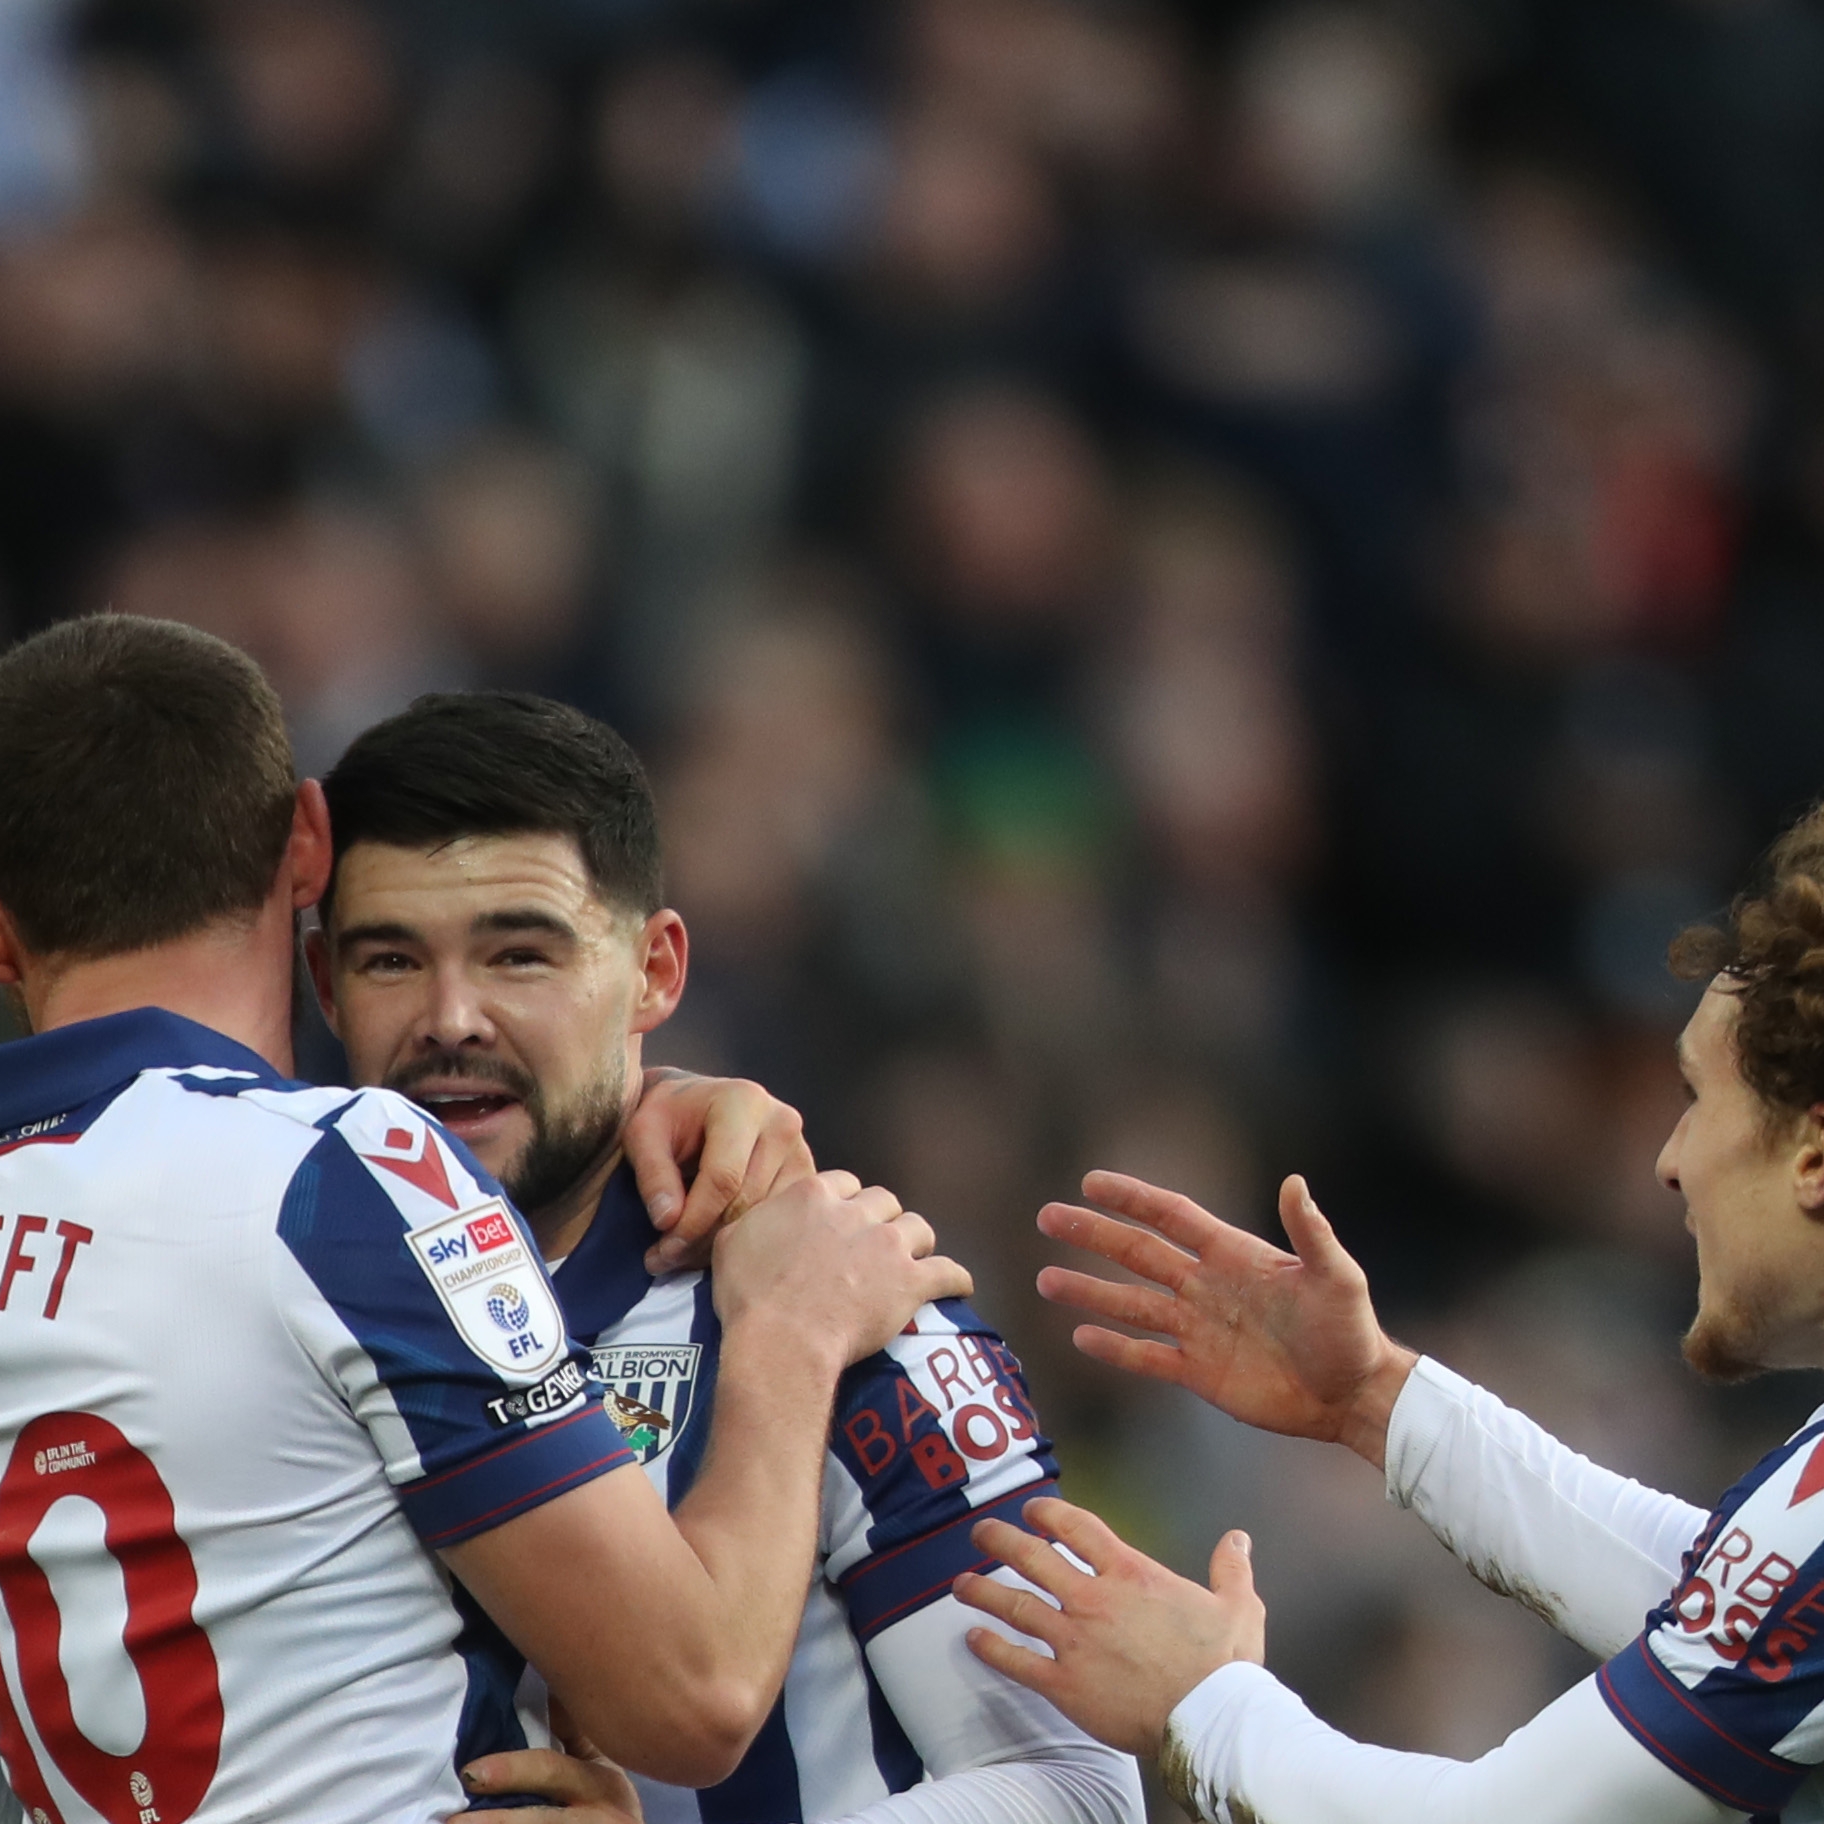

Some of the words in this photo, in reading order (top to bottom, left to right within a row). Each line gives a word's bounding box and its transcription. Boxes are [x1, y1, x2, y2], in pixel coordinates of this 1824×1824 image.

[427, 1233, 468, 1264] sky
[471, 1217, 509, 1246] bet
[442, 1248, 523, 1288] CHAMPIONSHIP
[507, 1332, 544, 1359] EFL
[624, 1349, 692, 1359] BROMWICH
[590, 1358, 691, 1379] ALBION
[48, 1451, 96, 1474] COMMUNITY
